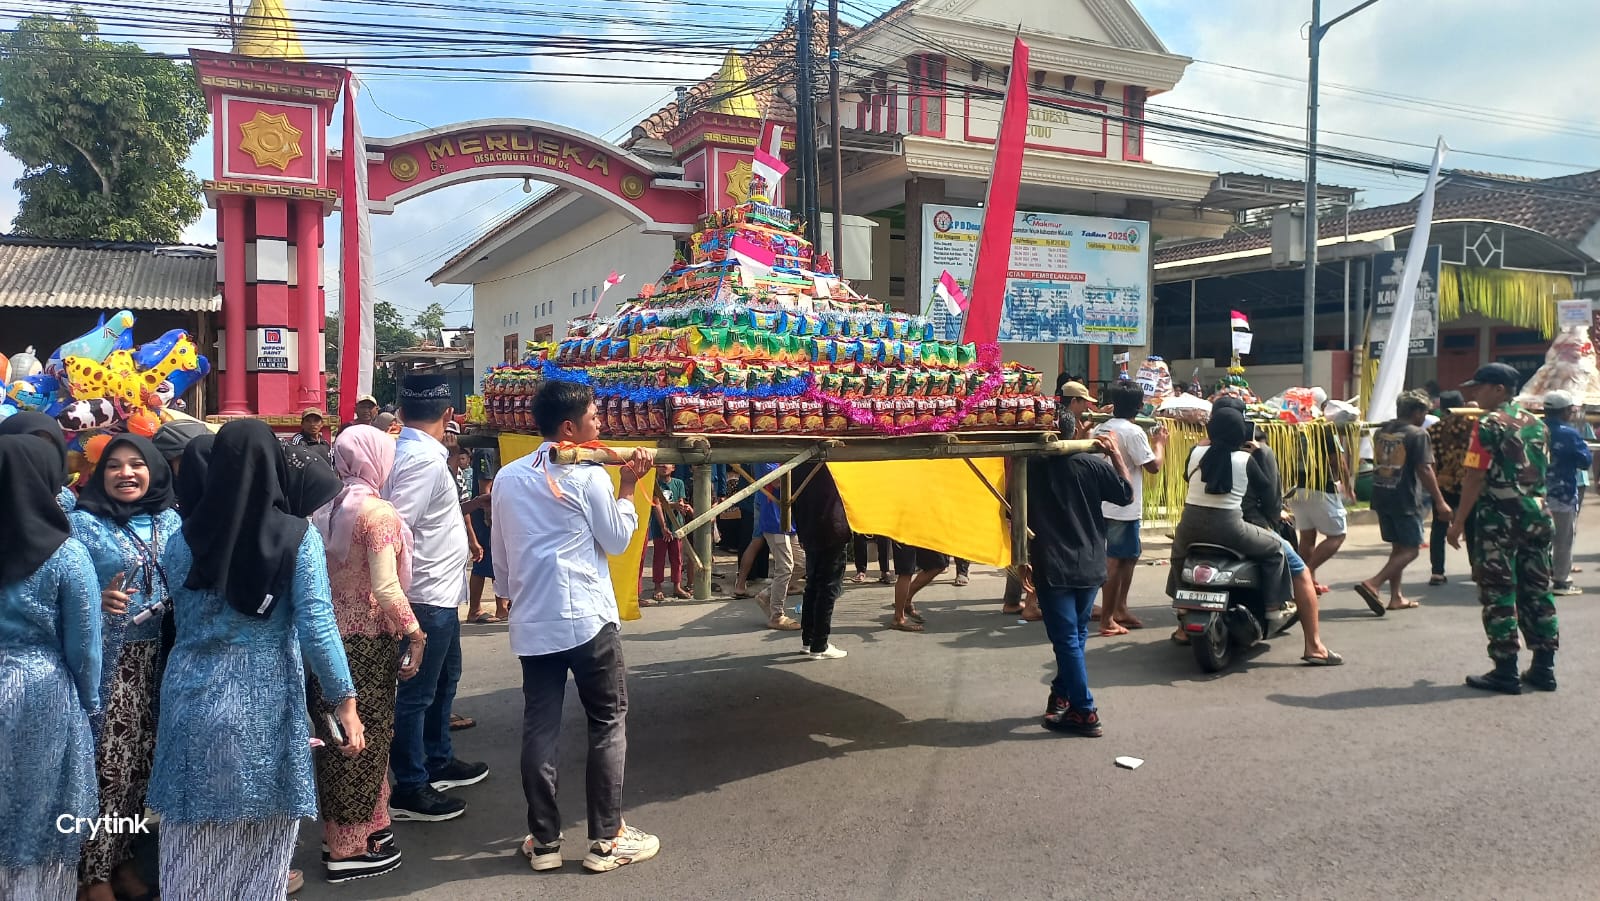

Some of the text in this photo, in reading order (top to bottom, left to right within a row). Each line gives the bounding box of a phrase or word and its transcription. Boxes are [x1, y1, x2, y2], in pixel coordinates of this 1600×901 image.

[424, 130, 609, 176] MERDEKA
[474, 153, 495, 164] DESA
[543, 155, 557, 166] RW
[1107, 231, 1128, 241] 2025
